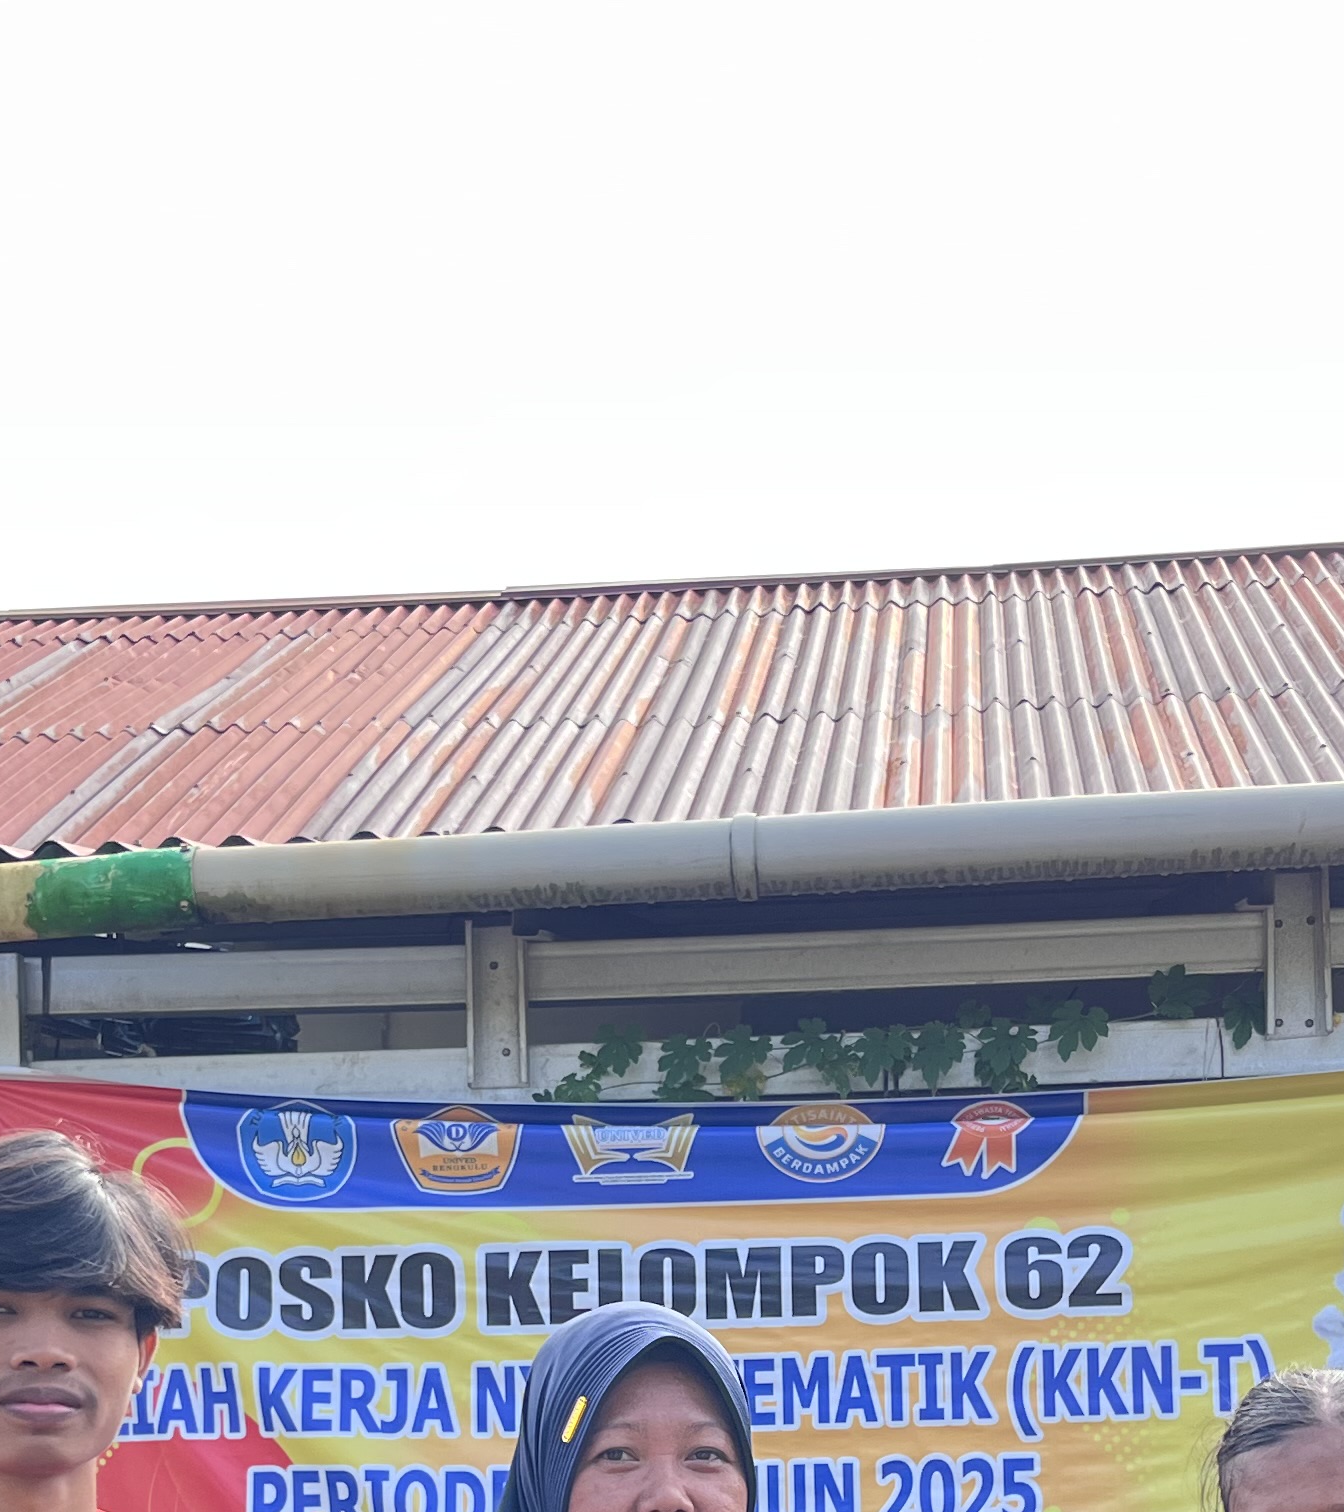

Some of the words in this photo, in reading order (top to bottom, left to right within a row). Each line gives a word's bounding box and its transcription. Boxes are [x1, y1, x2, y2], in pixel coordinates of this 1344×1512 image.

[773, 1143, 869, 1175] BERDAMPAK
[1005, 1234, 1123, 1310] 62
[119, 1367, 241, 1435] IAH
[260, 1366, 455, 1434] KERJA
[735, 1351, 993, 1426] EMATIK
